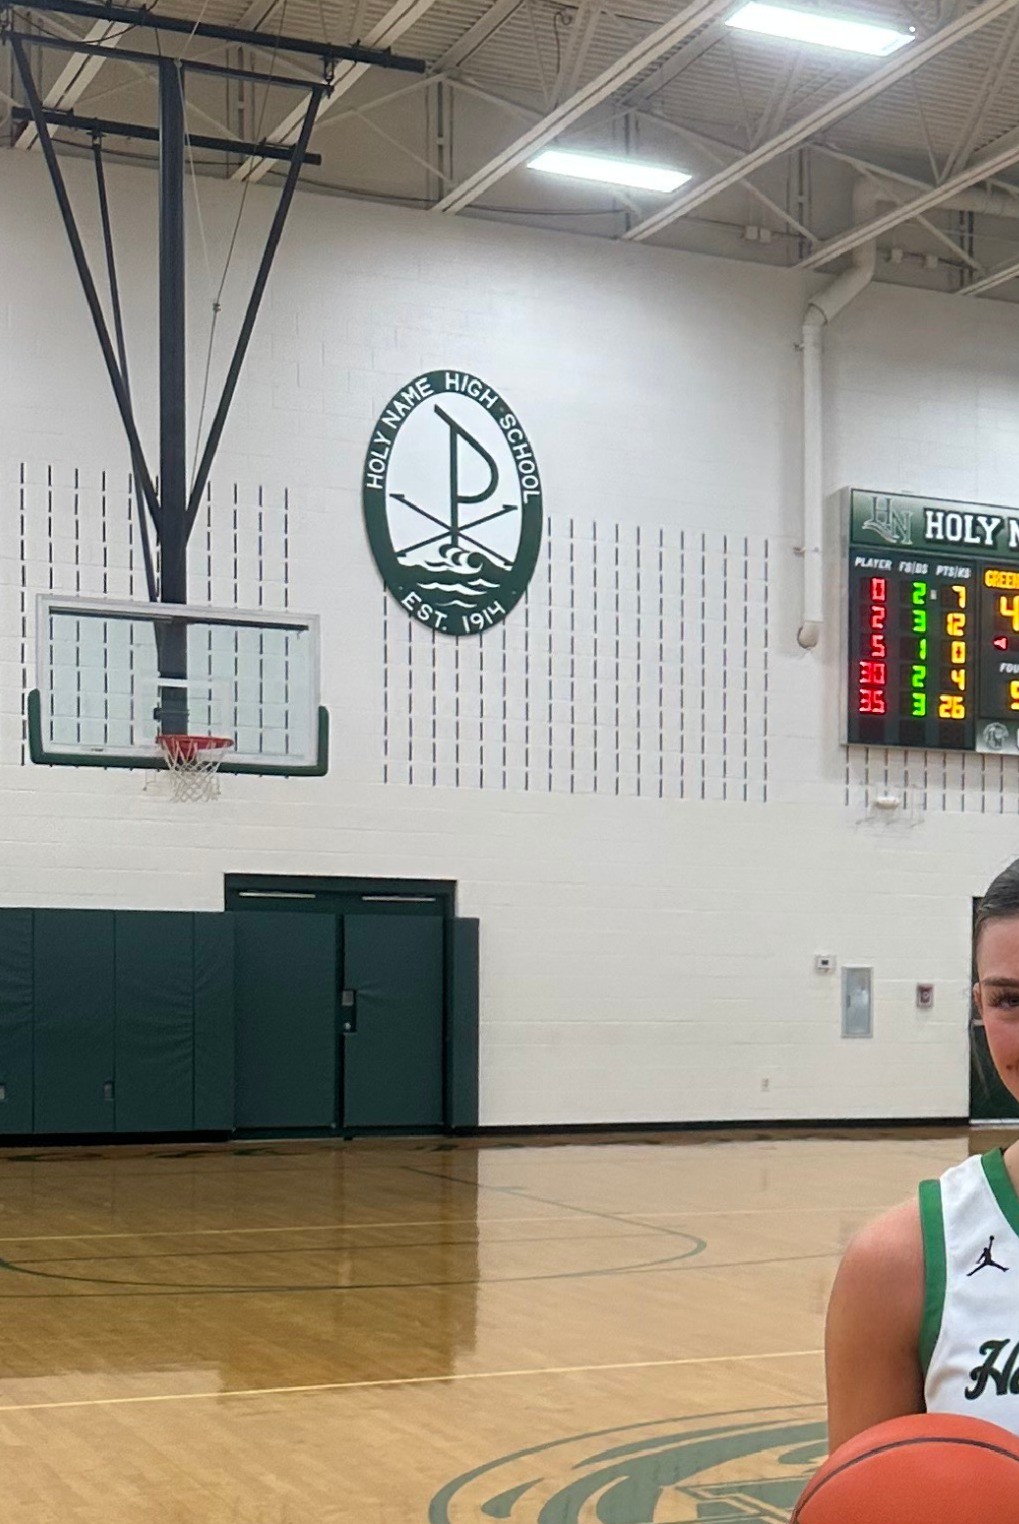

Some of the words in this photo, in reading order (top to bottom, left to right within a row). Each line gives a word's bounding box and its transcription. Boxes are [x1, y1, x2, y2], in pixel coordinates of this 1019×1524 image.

[366, 431, 391, 489] HOLY
[382, 377, 434, 429] NAME
[445, 372, 498, 409] HIGH
[500, 413, 540, 504] SCHOOL
[925, 510, 1001, 546] HOLY
[855, 557, 892, 571] PLAYER
[872, 578, 885, 601] 0
[912, 582, 926, 604] 2
[952, 585, 966, 608] 7
[401, 591, 448, 630] EST.
[462, 600, 506, 633] 1914
[872, 606, 885, 629] 2
[912, 610, 926, 632] 3
[872, 635, 885, 657] 5
[919, 638, 926, 660] 1
[951, 641, 966, 663] 0
[912, 665, 926, 687] 2
[951, 669, 965, 690] 4
[912, 693, 926, 716] 3
